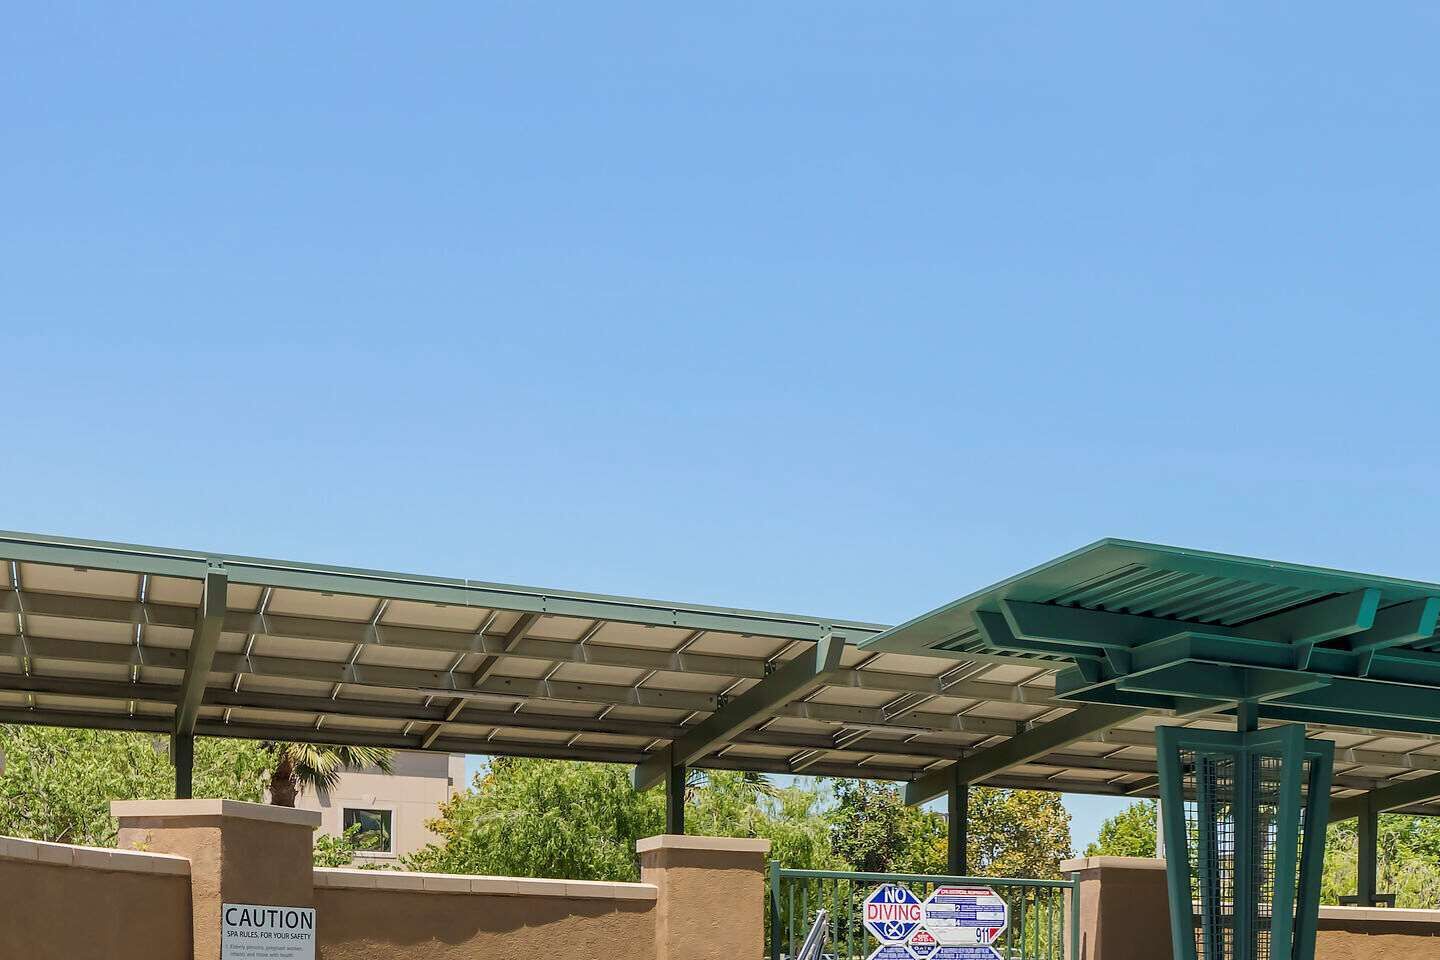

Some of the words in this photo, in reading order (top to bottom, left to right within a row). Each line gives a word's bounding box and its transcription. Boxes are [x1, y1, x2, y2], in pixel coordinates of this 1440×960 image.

[884, 887, 906, 903] NO
[225, 908, 312, 929] CAUTION
[868, 904, 920, 921] DIVING
[976, 928, 989, 944] 911
